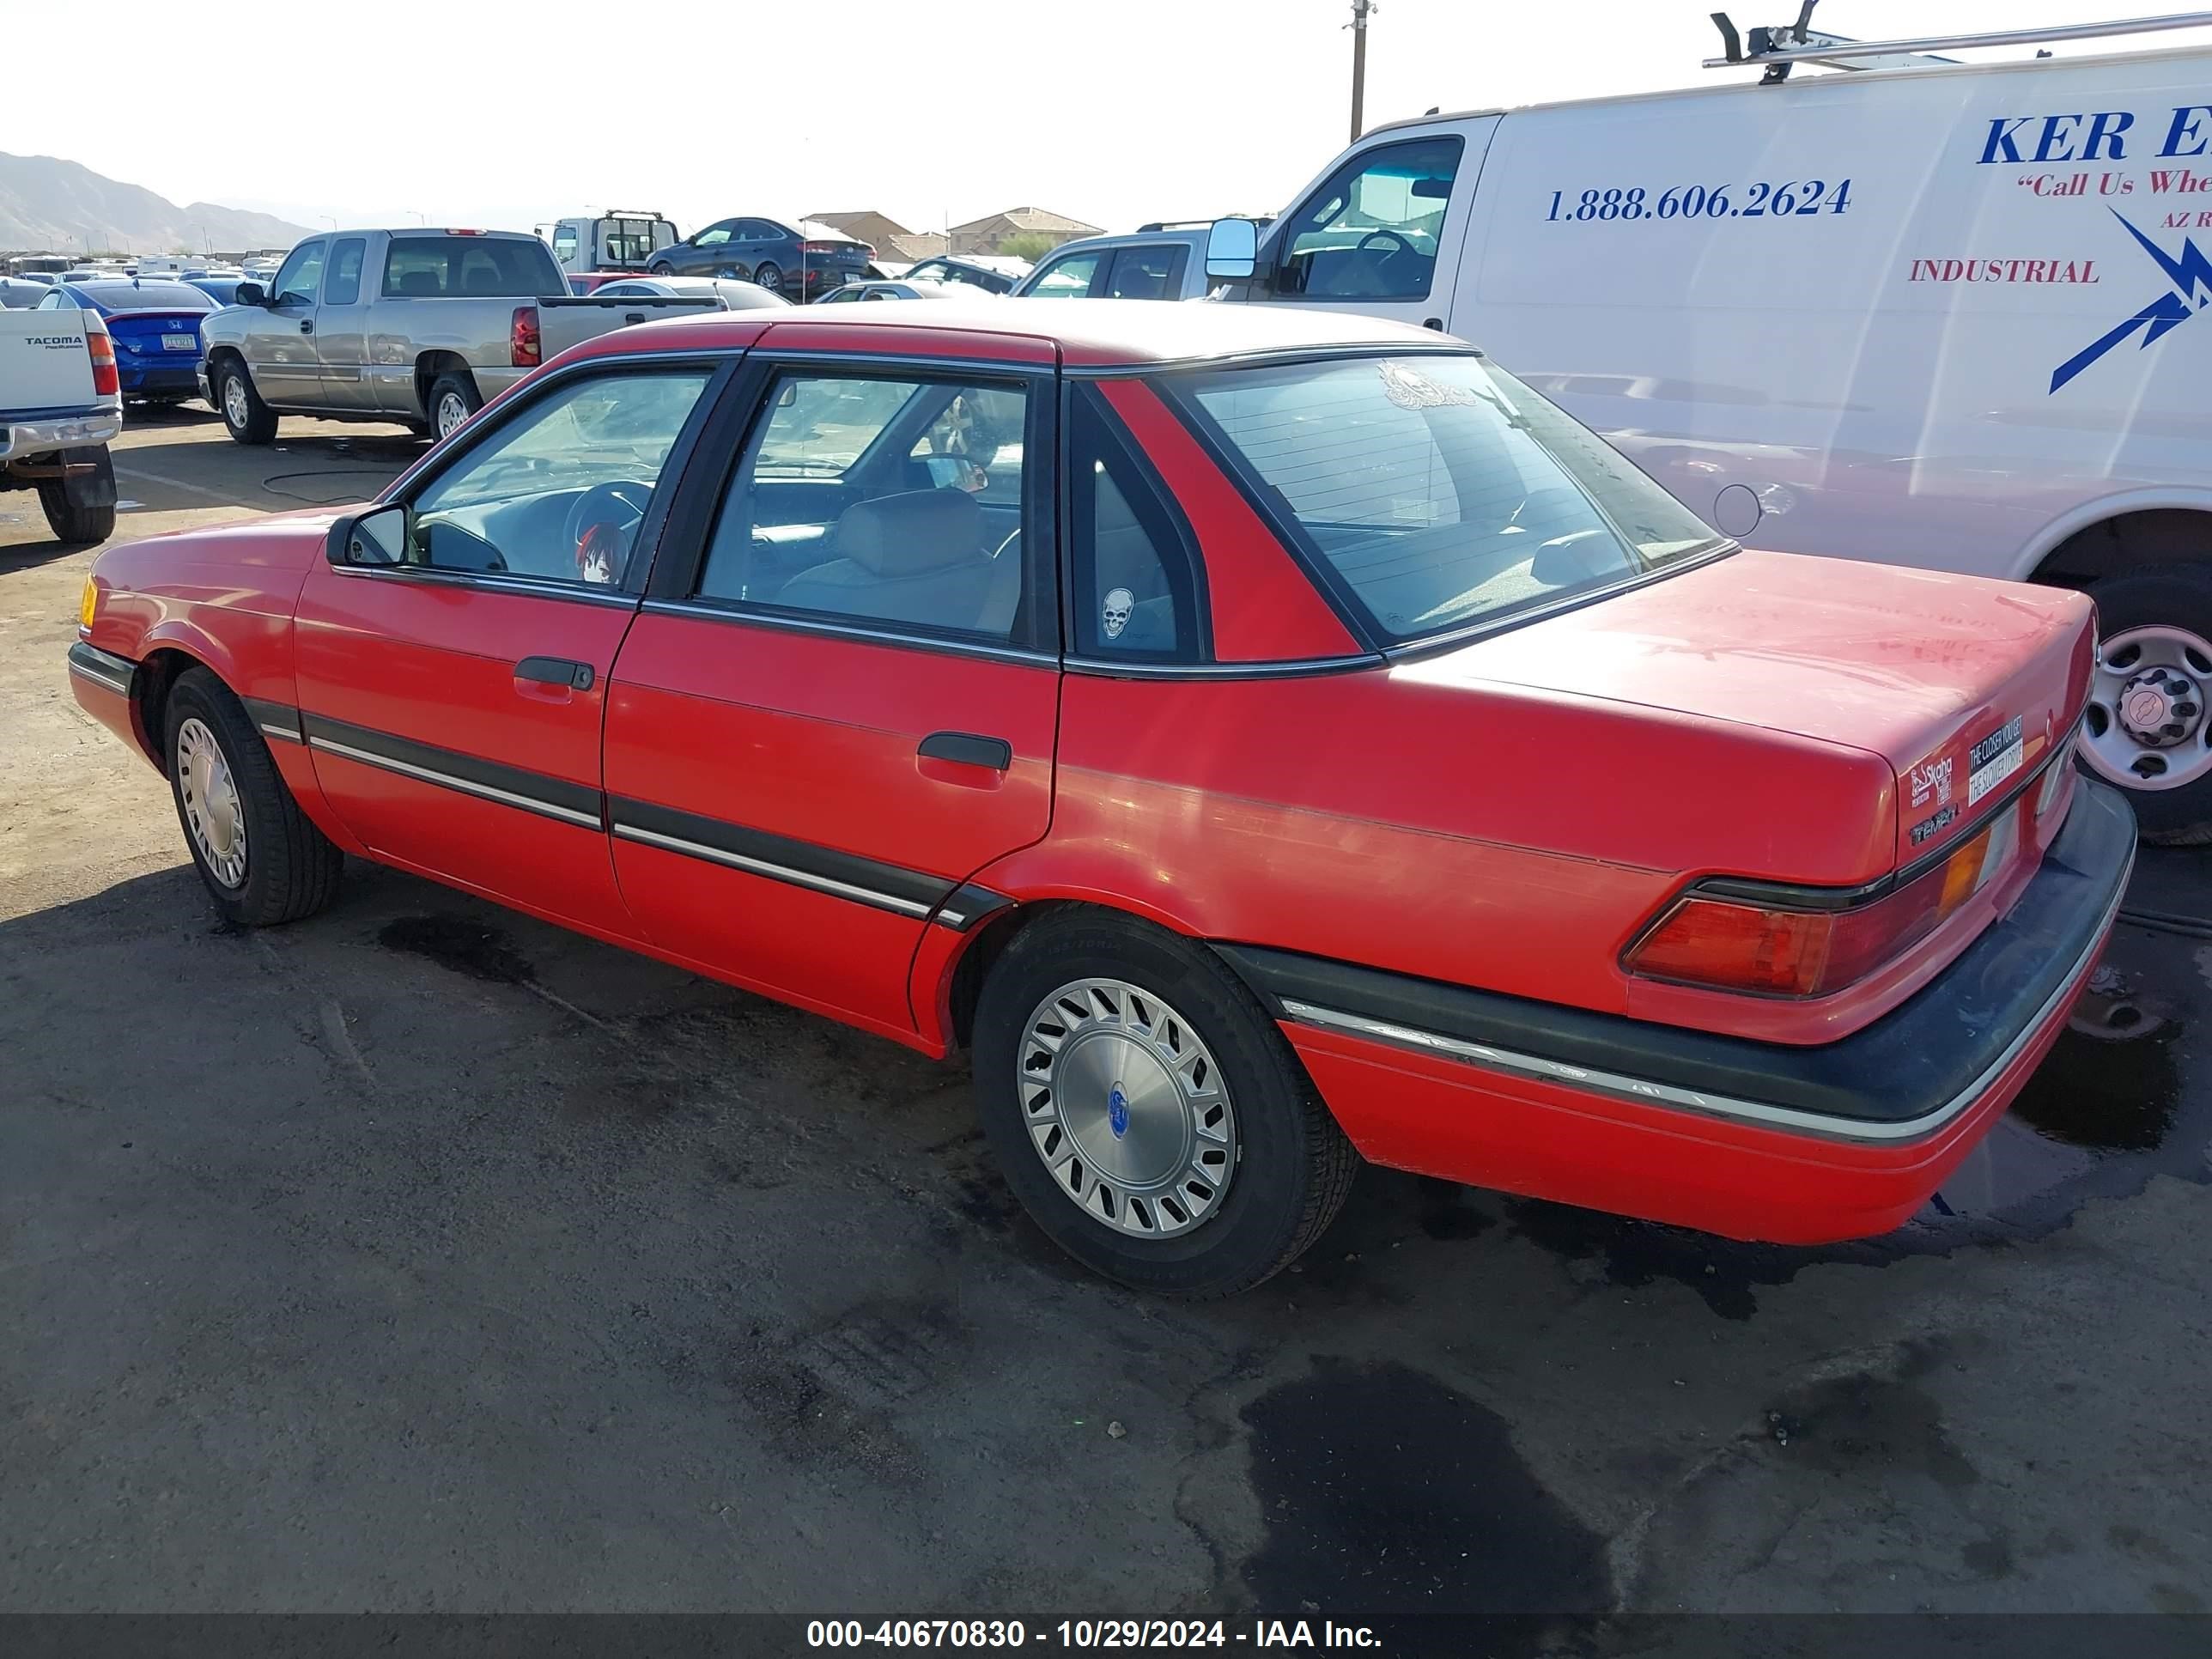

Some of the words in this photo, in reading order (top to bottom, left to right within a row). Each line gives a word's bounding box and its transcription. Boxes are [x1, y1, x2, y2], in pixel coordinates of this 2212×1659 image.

[1976, 112, 2135, 164] KER
[2154, 105, 2212, 158] E
[1545, 179, 1851, 222] 1.888.606.2624
[2099, 172, 2135, 196] Us
[2160, 212, 2191, 228] AZ
[1907, 259, 2100, 283] INDUSTRIAL
[1970, 744, 1982, 769] THE
[1982, 730, 2002, 761] CLOSER
[2002, 721, 2014, 745] YOU
[2013, 714, 2022, 737] GET
[1926, 757, 1952, 785] Skaha
[1970, 775, 1982, 801] THE
[1982, 757, 2005, 793] SLOWER
